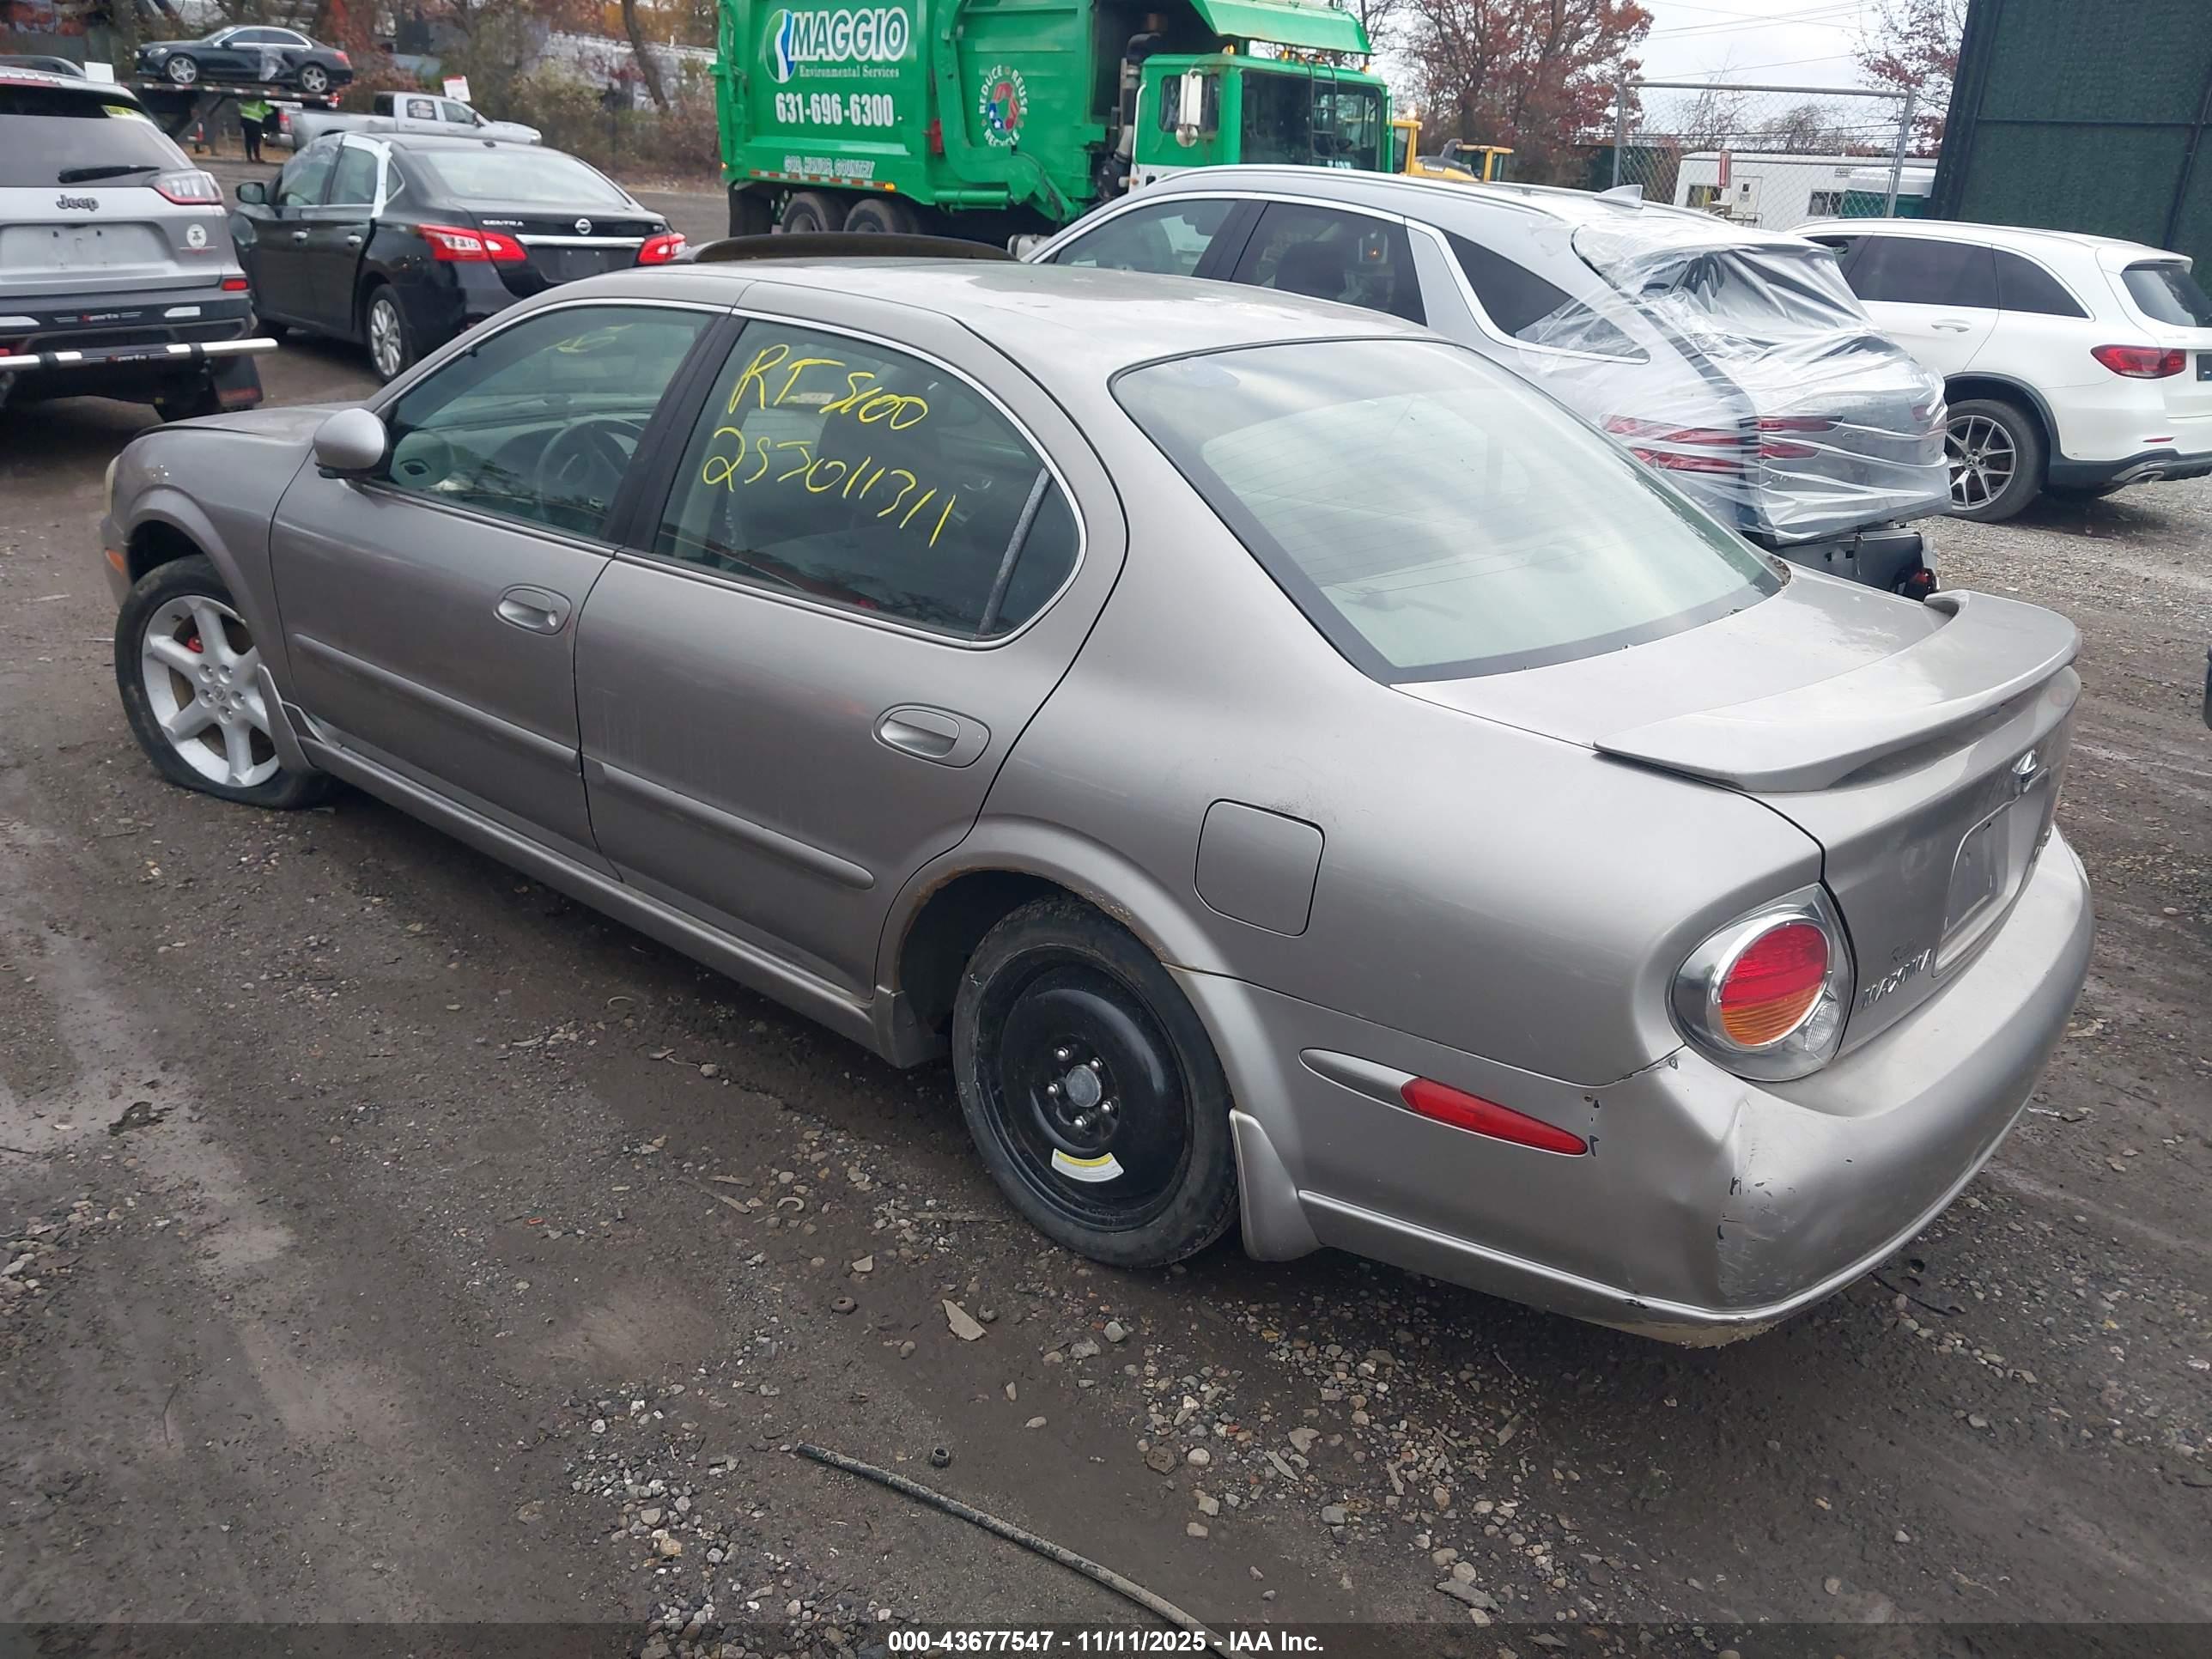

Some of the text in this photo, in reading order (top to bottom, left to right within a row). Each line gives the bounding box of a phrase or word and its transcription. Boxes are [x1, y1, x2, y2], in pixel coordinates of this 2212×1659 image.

[788, 7, 908, 62] MAGGIO
[799, 65, 899, 78] Environmental Services
[979, 64, 1003, 114] REDUCE
[775, 92, 894, 127] 631-696-6300
[1012, 69, 1029, 115] REUSE
[56, 194, 100, 212] Jeep
